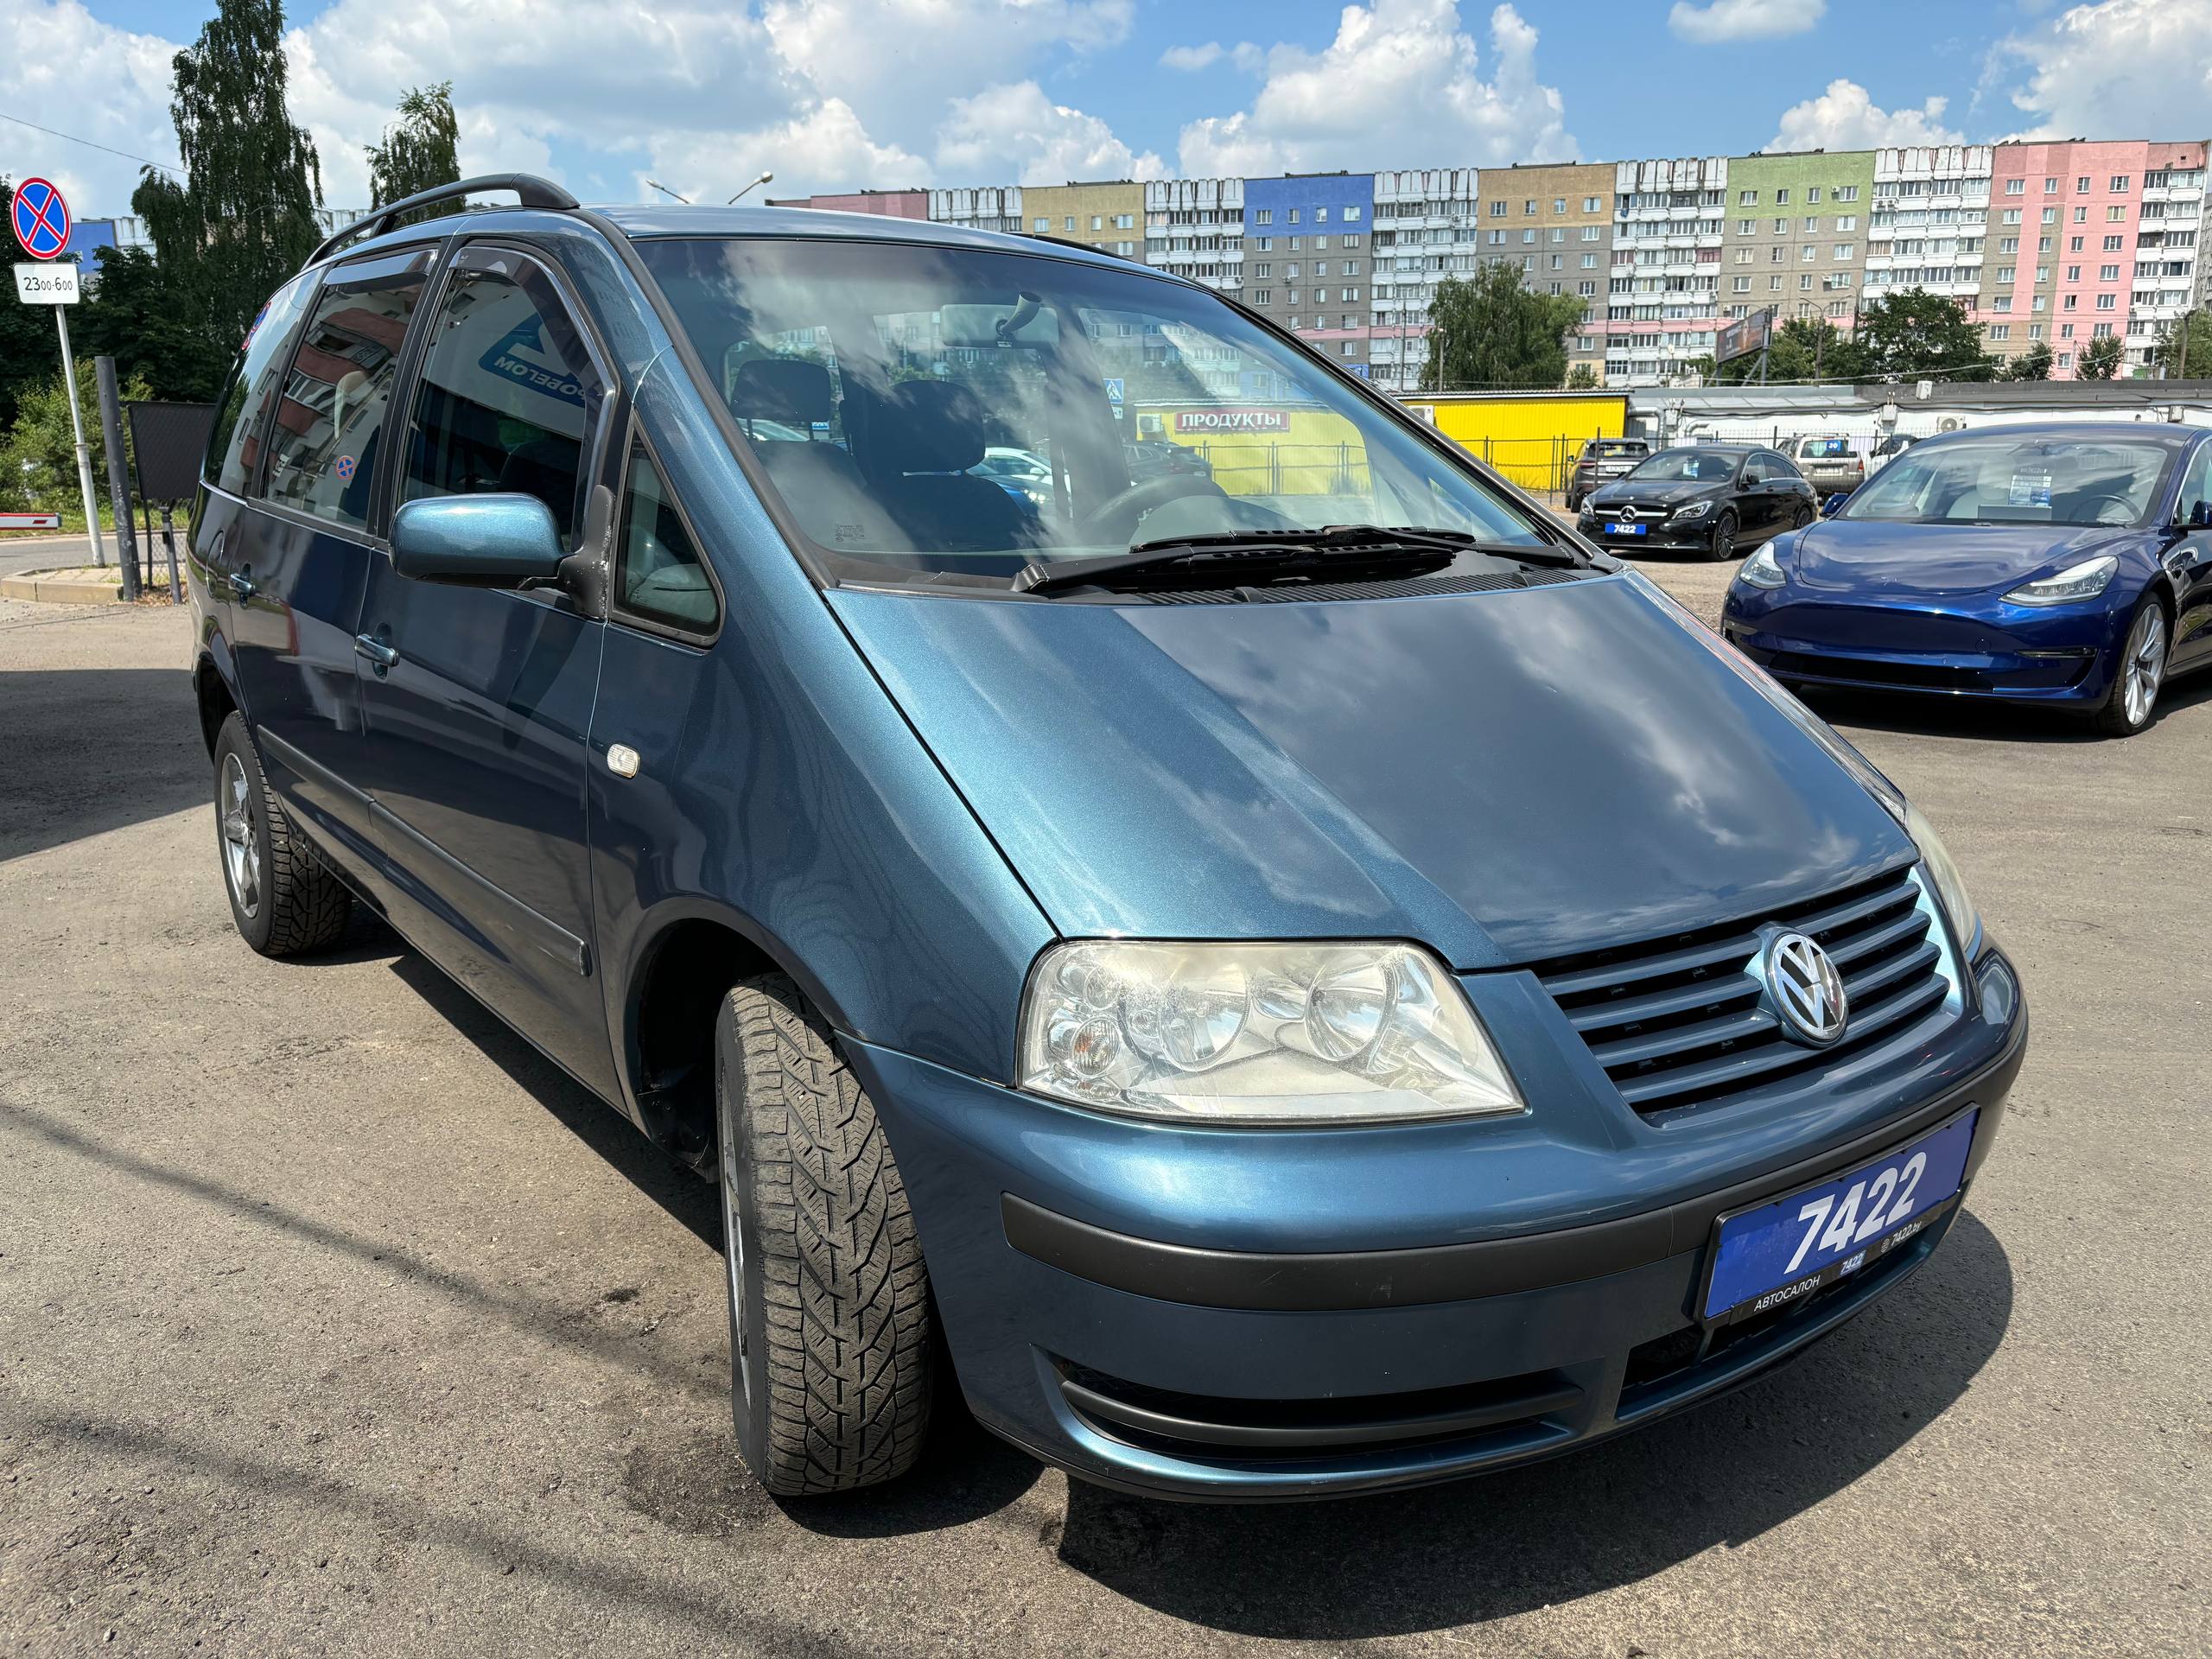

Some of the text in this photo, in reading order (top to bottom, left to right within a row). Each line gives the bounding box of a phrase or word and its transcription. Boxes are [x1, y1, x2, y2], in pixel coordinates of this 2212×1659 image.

[1181, 412, 1281, 428] ПРОДУКТЫ
[1613, 524, 1637, 534] 7422
[1783, 1151, 1927, 1274] 7422
[1891, 1221, 1923, 1246] 7422.by
[1840, 1252, 1865, 1273] 7422
[1753, 1274, 1821, 1313] АВТОСАЛОН
